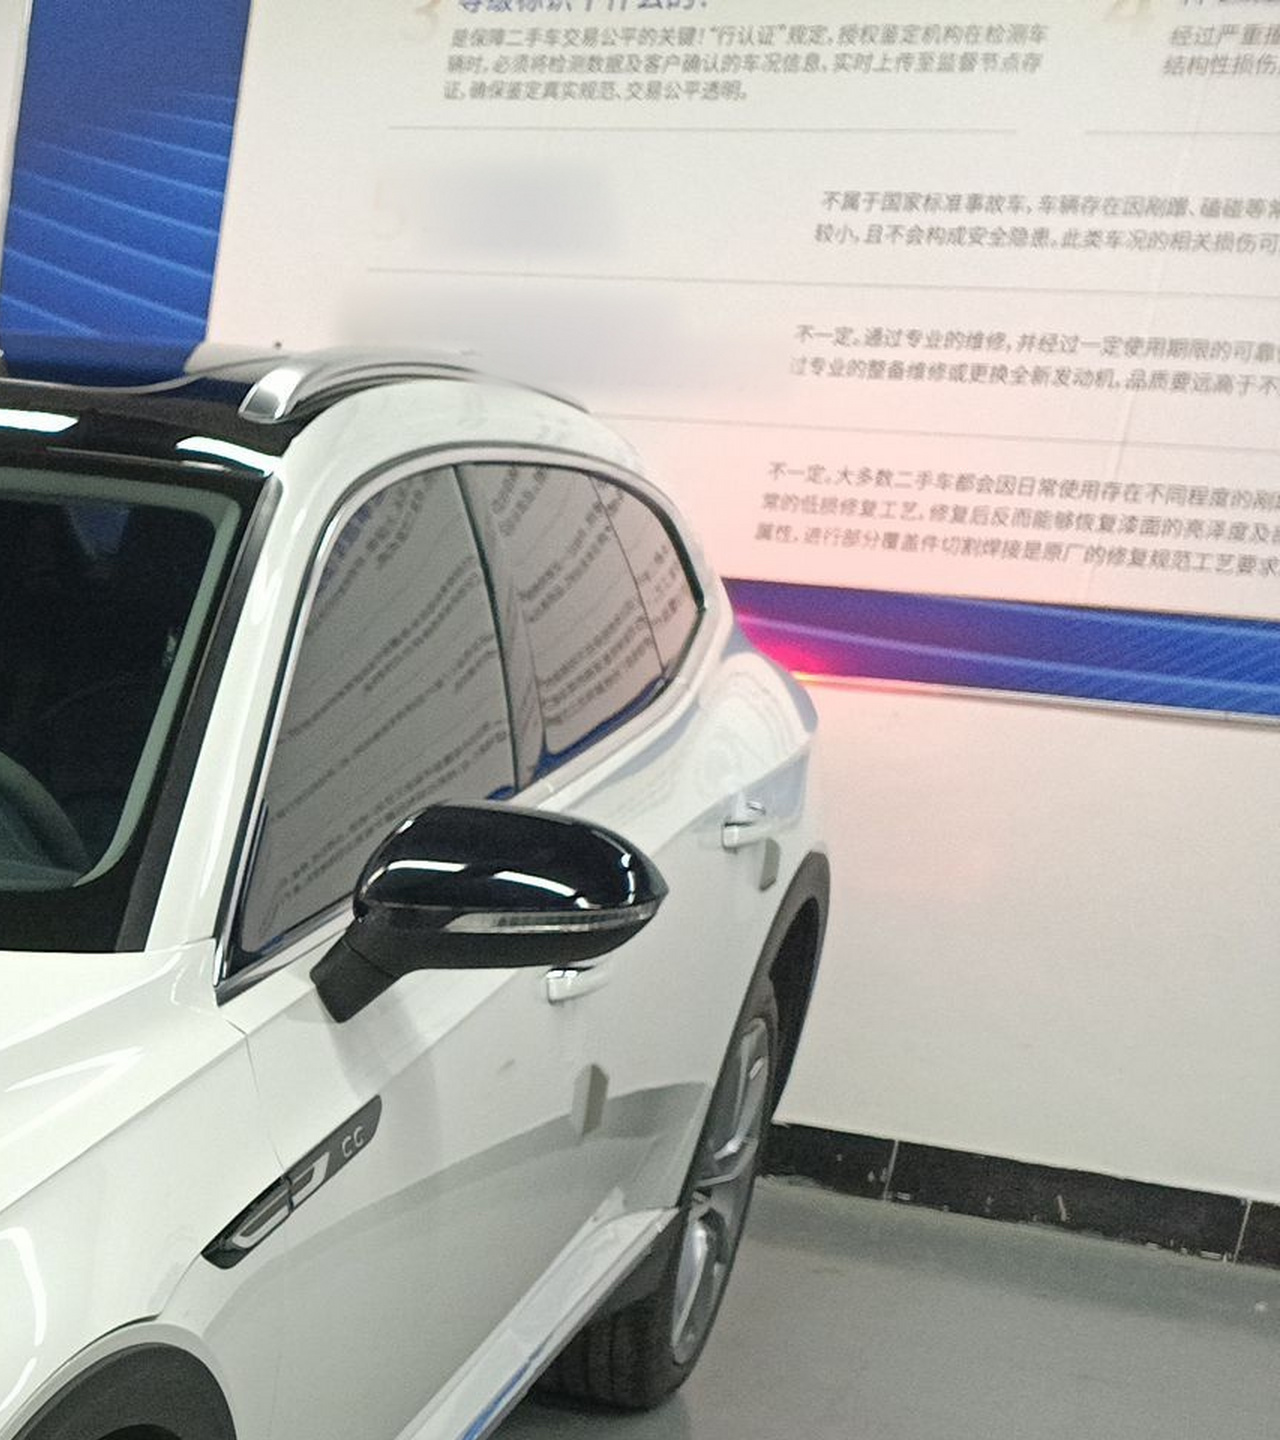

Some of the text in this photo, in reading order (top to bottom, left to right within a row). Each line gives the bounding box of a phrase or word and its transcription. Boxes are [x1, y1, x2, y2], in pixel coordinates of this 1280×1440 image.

[795, 324, 1280, 364] 不一定。通过专业的维修，并经过一定使用期限的可靠
[769, 461, 1280, 512] 不一定。大多数二手车都会因日常使用存在不同程度的剐
